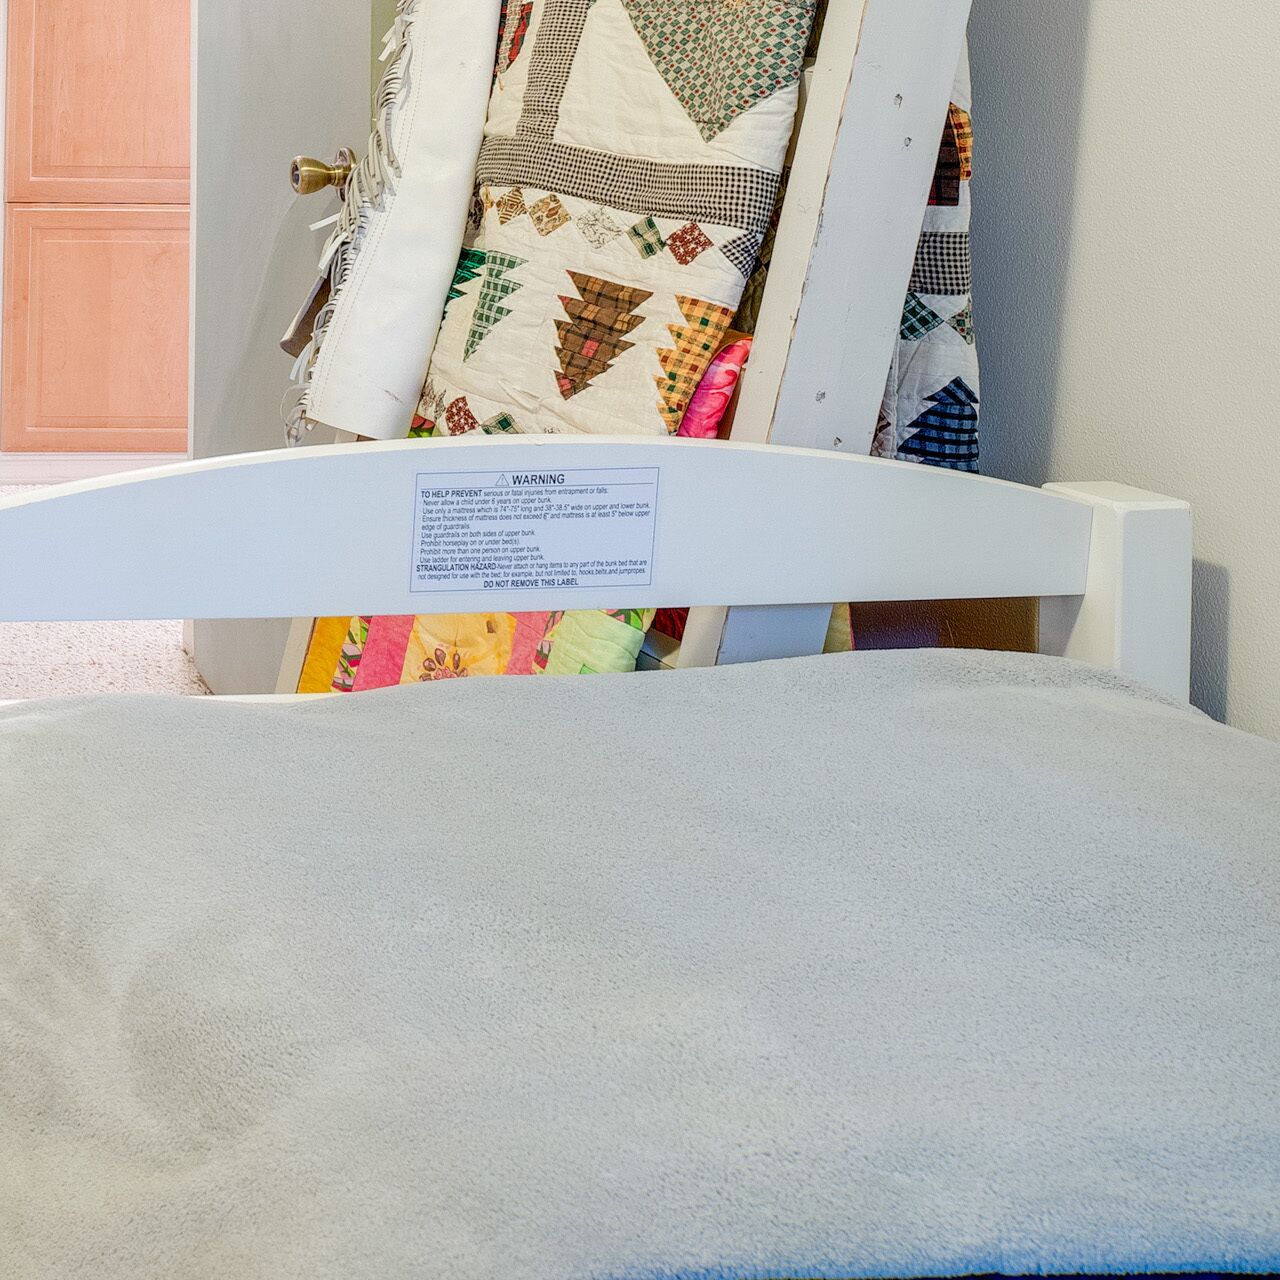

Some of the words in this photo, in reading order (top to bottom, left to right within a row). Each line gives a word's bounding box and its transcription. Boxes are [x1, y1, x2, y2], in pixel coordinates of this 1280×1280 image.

[512, 474, 565, 485] WARNING
[432, 490, 450, 498] HELP
[451, 489, 482, 498] PREVENT
[417, 563, 470, 572] STRANGULATION
[484, 580, 494, 588] DO
[495, 579, 510, 587] NOT
[511, 578, 540, 587] REMOVE
[541, 578, 556, 586] THIS
[557, 577, 578, 586] LABEL
